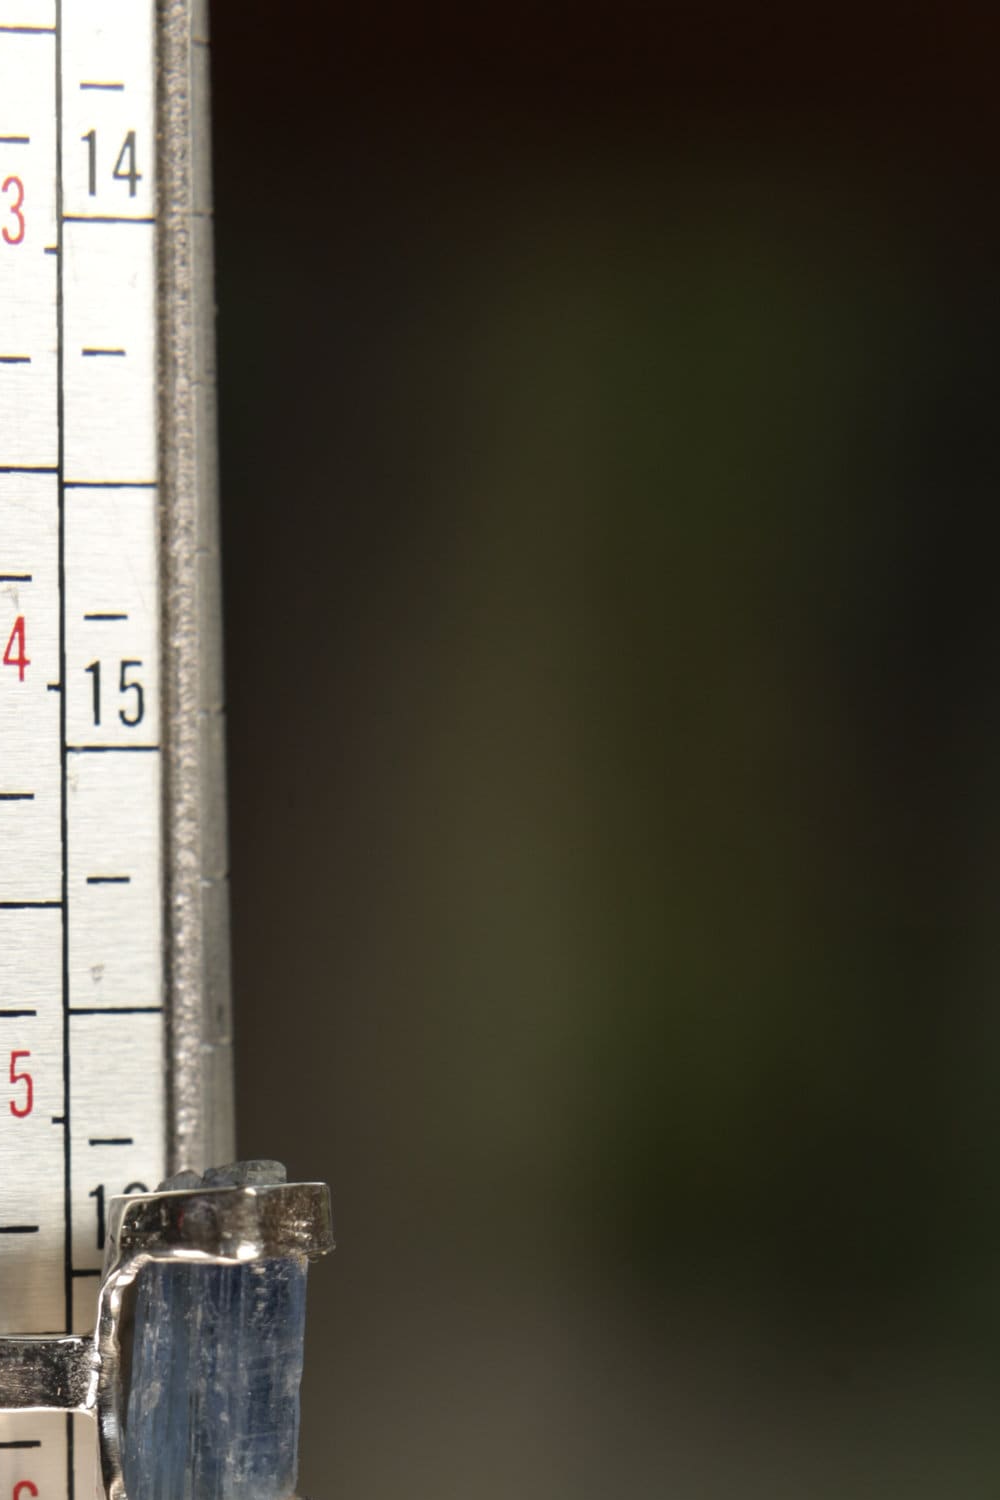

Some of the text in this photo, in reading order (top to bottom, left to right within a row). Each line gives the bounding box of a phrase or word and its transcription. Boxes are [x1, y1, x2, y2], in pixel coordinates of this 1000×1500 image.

[80, 129, 142, 199] 14
[1, 175, 28, 246] 3
[2, 615, 31, 683] 4
[85, 660, 146, 728] 15
[9, 1049, 34, 1119] 5
[89, 1181, 149, 1251] 1
